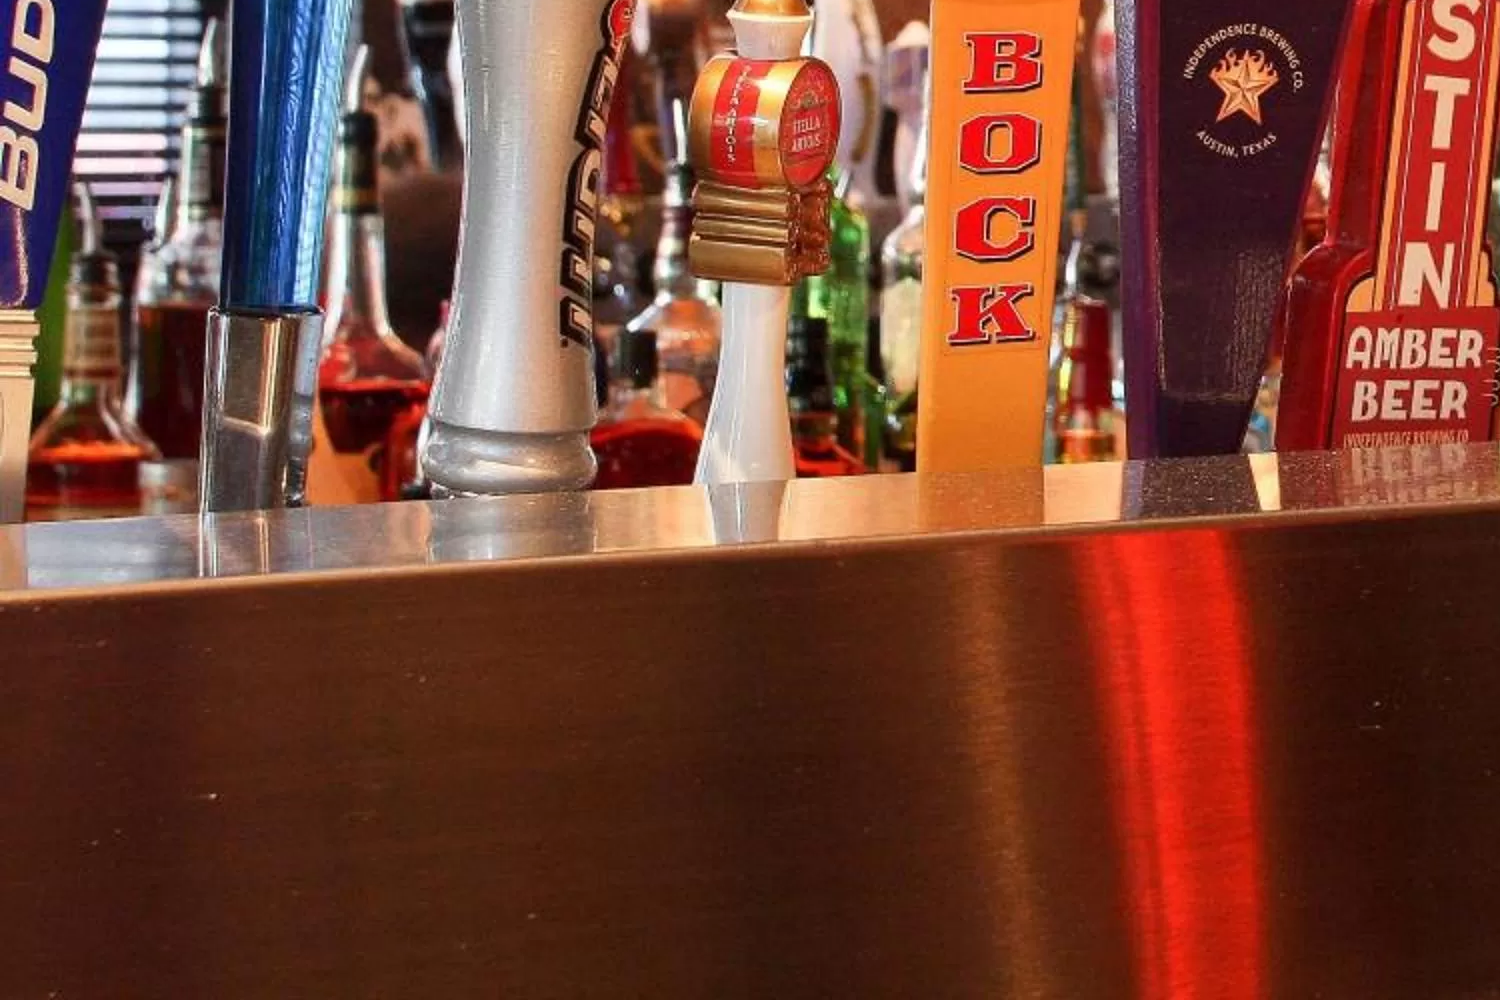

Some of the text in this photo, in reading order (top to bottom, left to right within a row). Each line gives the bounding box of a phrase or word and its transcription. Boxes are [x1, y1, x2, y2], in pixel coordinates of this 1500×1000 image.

[1183, 23, 1257, 80] INDEPENDENCE
[1259, 26, 1301, 69] BREWING
[1241, 131, 1278, 157] TEXAS
[945, 31, 1044, 347] BOCK
[1345, 326, 1483, 372] AMBER
[1350, 379, 1468, 422] BEER
